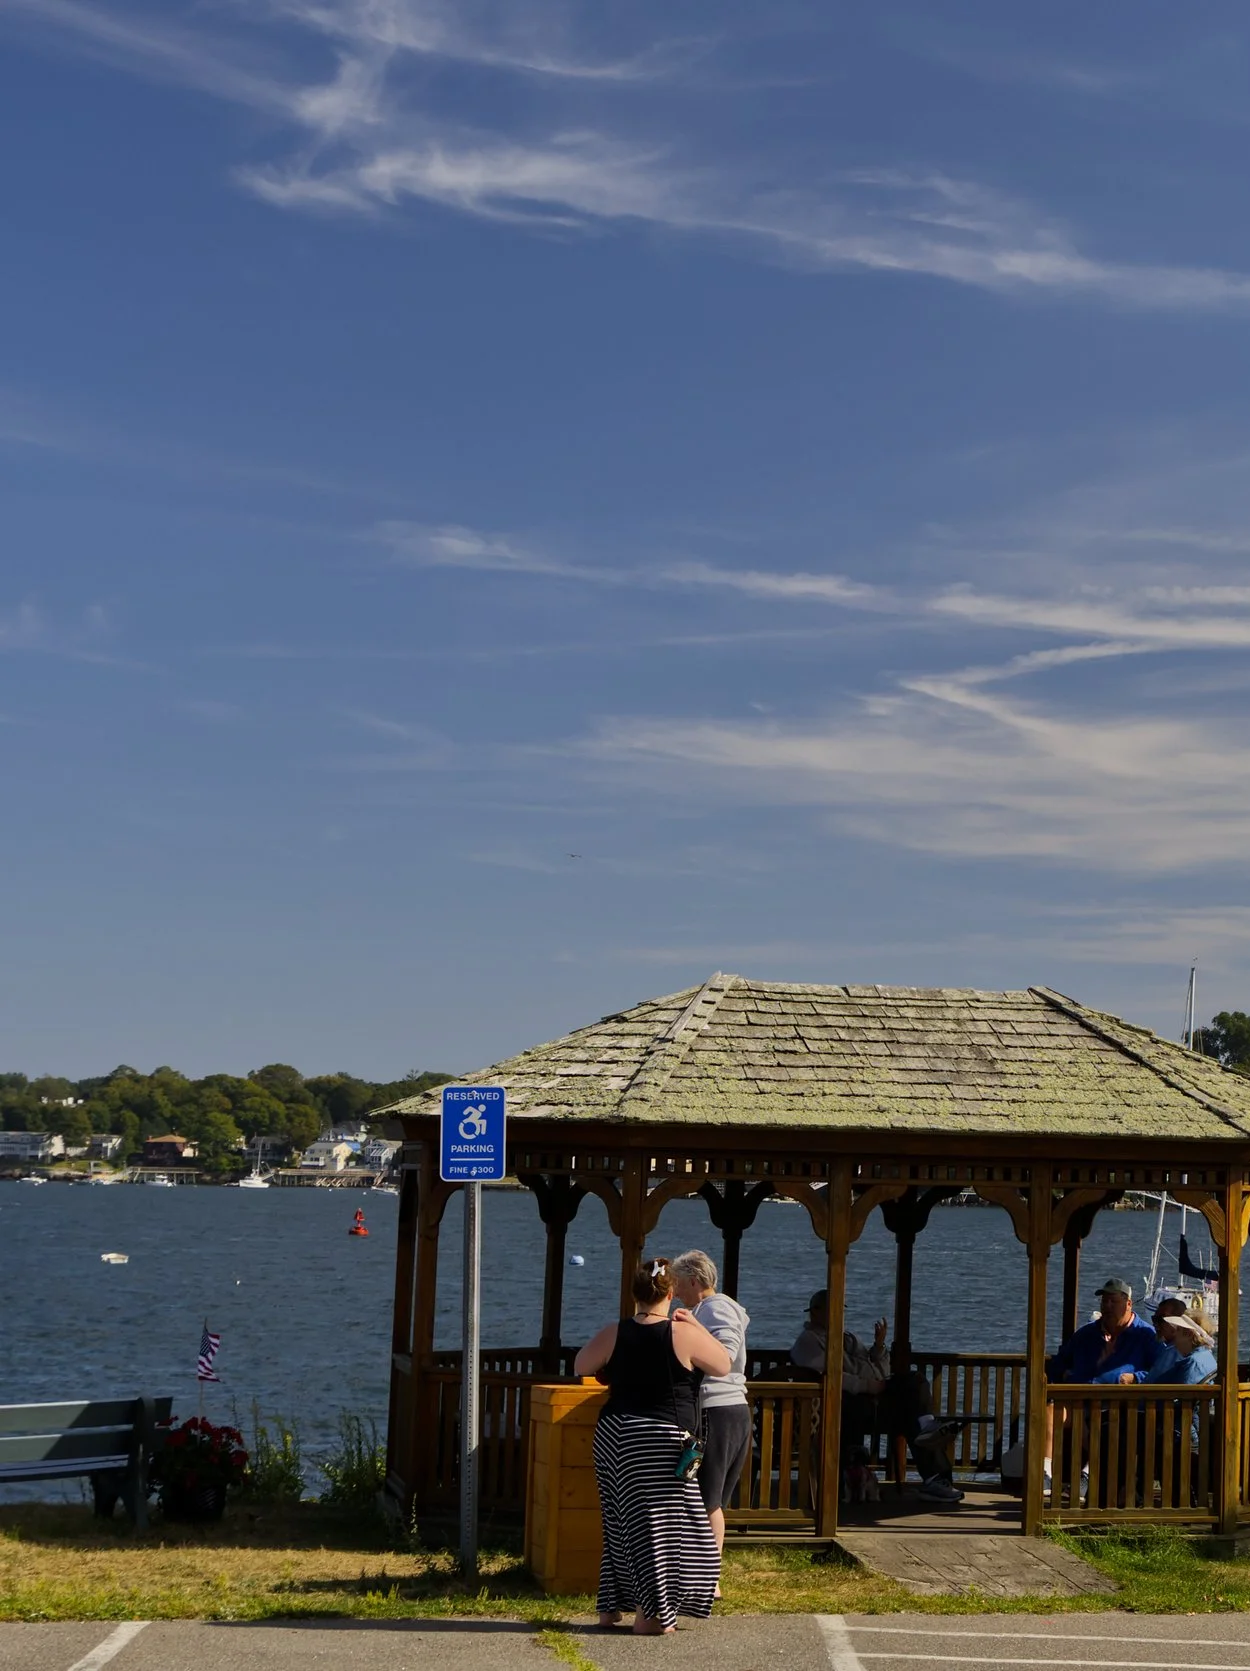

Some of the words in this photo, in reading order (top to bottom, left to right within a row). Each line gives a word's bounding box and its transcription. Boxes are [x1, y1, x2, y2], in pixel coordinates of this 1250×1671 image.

[446, 1092, 500, 1101] RESERVED
[451, 1145, 494, 1153] PARKING
[449, 1166, 468, 1174] FINE
[471, 1166, 494, 1174] $300
